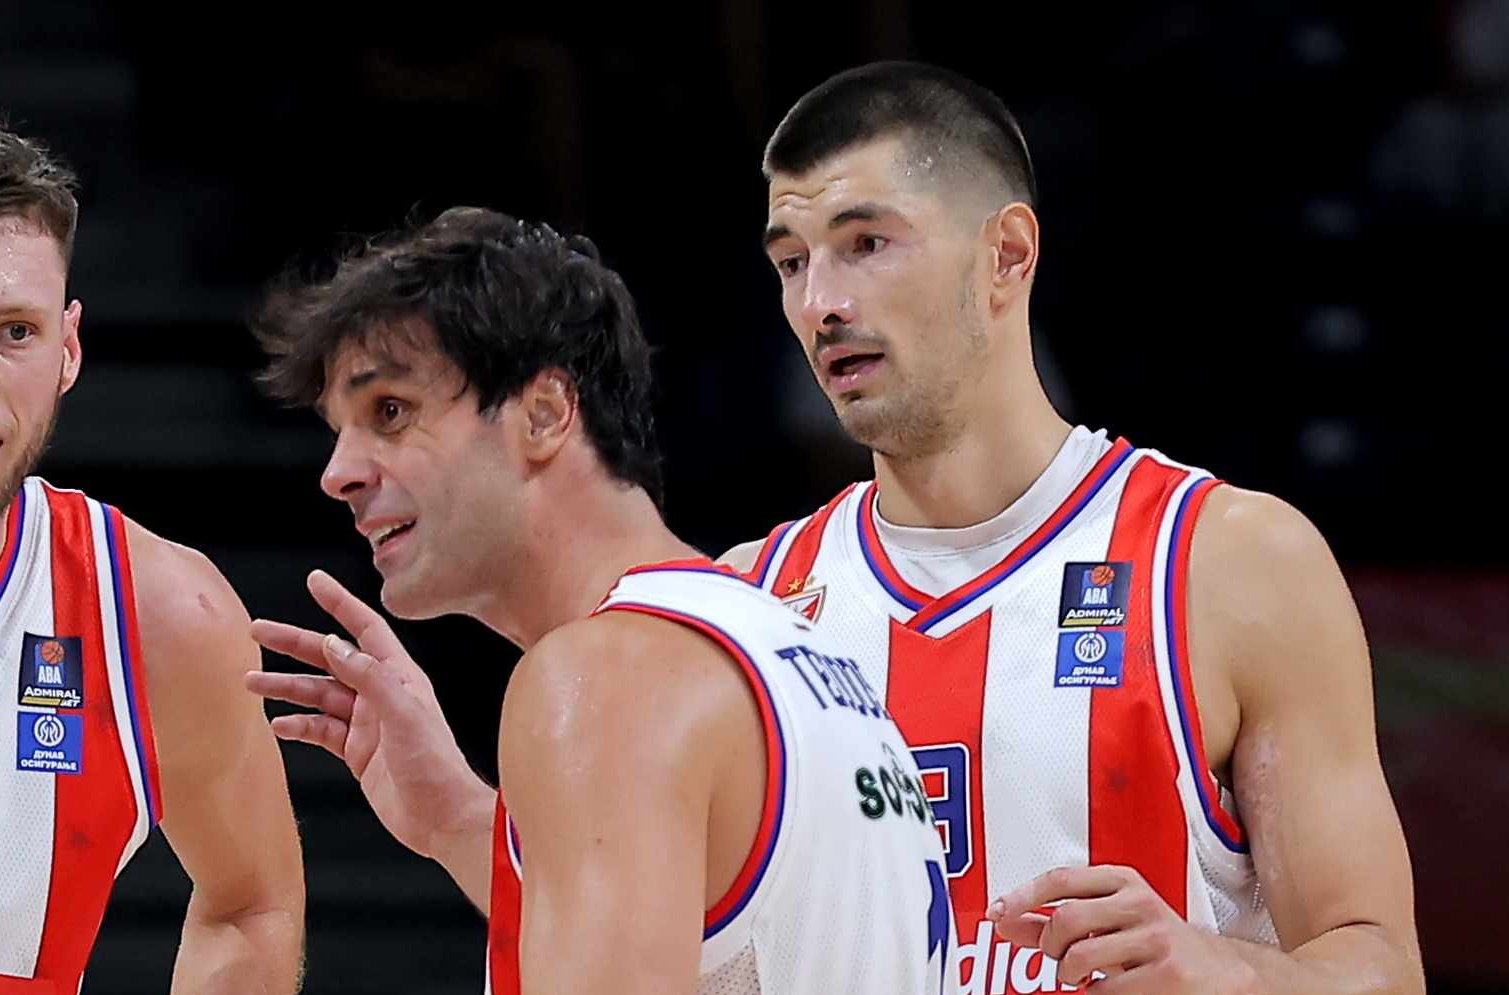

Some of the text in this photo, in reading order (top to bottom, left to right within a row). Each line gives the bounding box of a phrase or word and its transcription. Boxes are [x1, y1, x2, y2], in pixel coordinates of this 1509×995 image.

[1083, 588, 1108, 604] ABA
[1066, 608, 1124, 618] ADMIRAL
[38, 666, 61, 683] ABA
[24, 687, 80, 699] ADMIRAL
[34, 750, 64, 759] ДУНАВ
